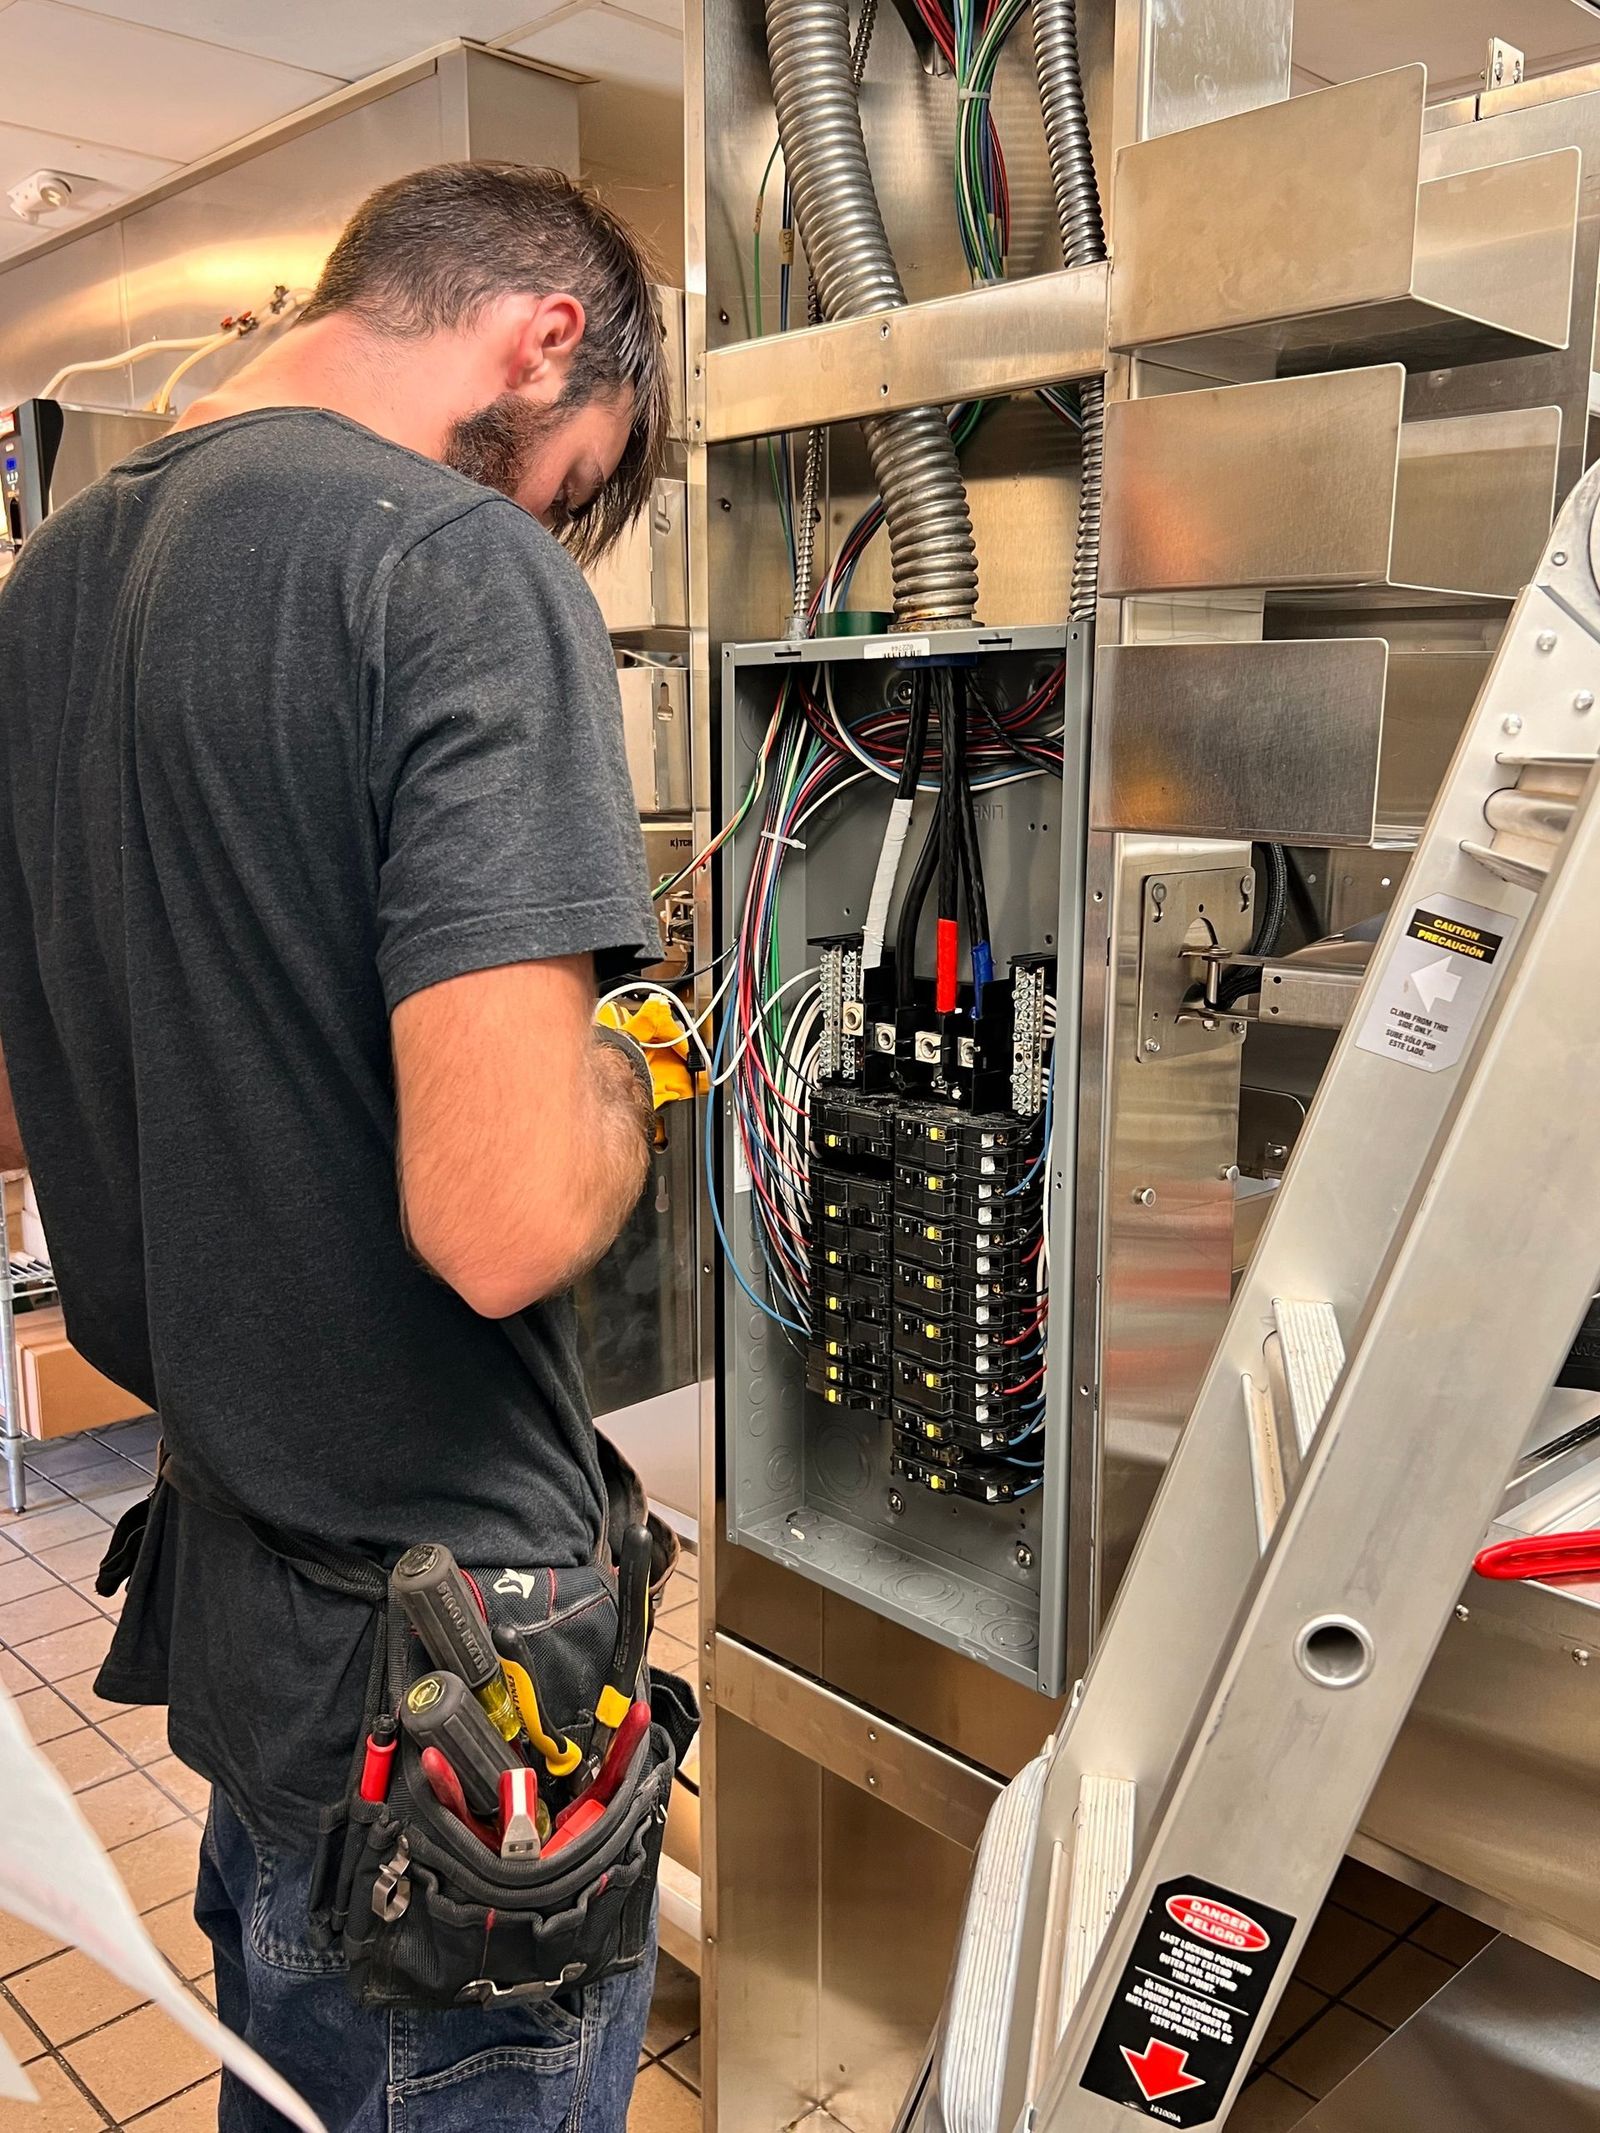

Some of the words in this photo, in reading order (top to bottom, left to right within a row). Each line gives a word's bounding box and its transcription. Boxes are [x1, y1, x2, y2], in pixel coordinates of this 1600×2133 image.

[1434, 920, 1480, 941] CAUTION
[1417, 930, 1485, 959] PRECAUCIÓN
[1390, 1008, 1412, 1021] CLIMB
[1412, 1015, 1432, 1028] FROM
[1434, 1020, 1449, 1032] THIS
[1397, 1019, 1413, 1031] SIDE
[1386, 1028, 1403, 1041] SUBE
[1423, 1040, 1436, 1051] POR
[1389, 1039, 1405, 1051] ESTE
[1190, 1900, 1251, 1932] DANGER
[1182, 1913, 1246, 1947] PELIGRO
[1171, 1947, 1183, 1958] DO
[1183, 1952, 1200, 1965] NOT
[1150, 2015, 1171, 2030] ESTE
